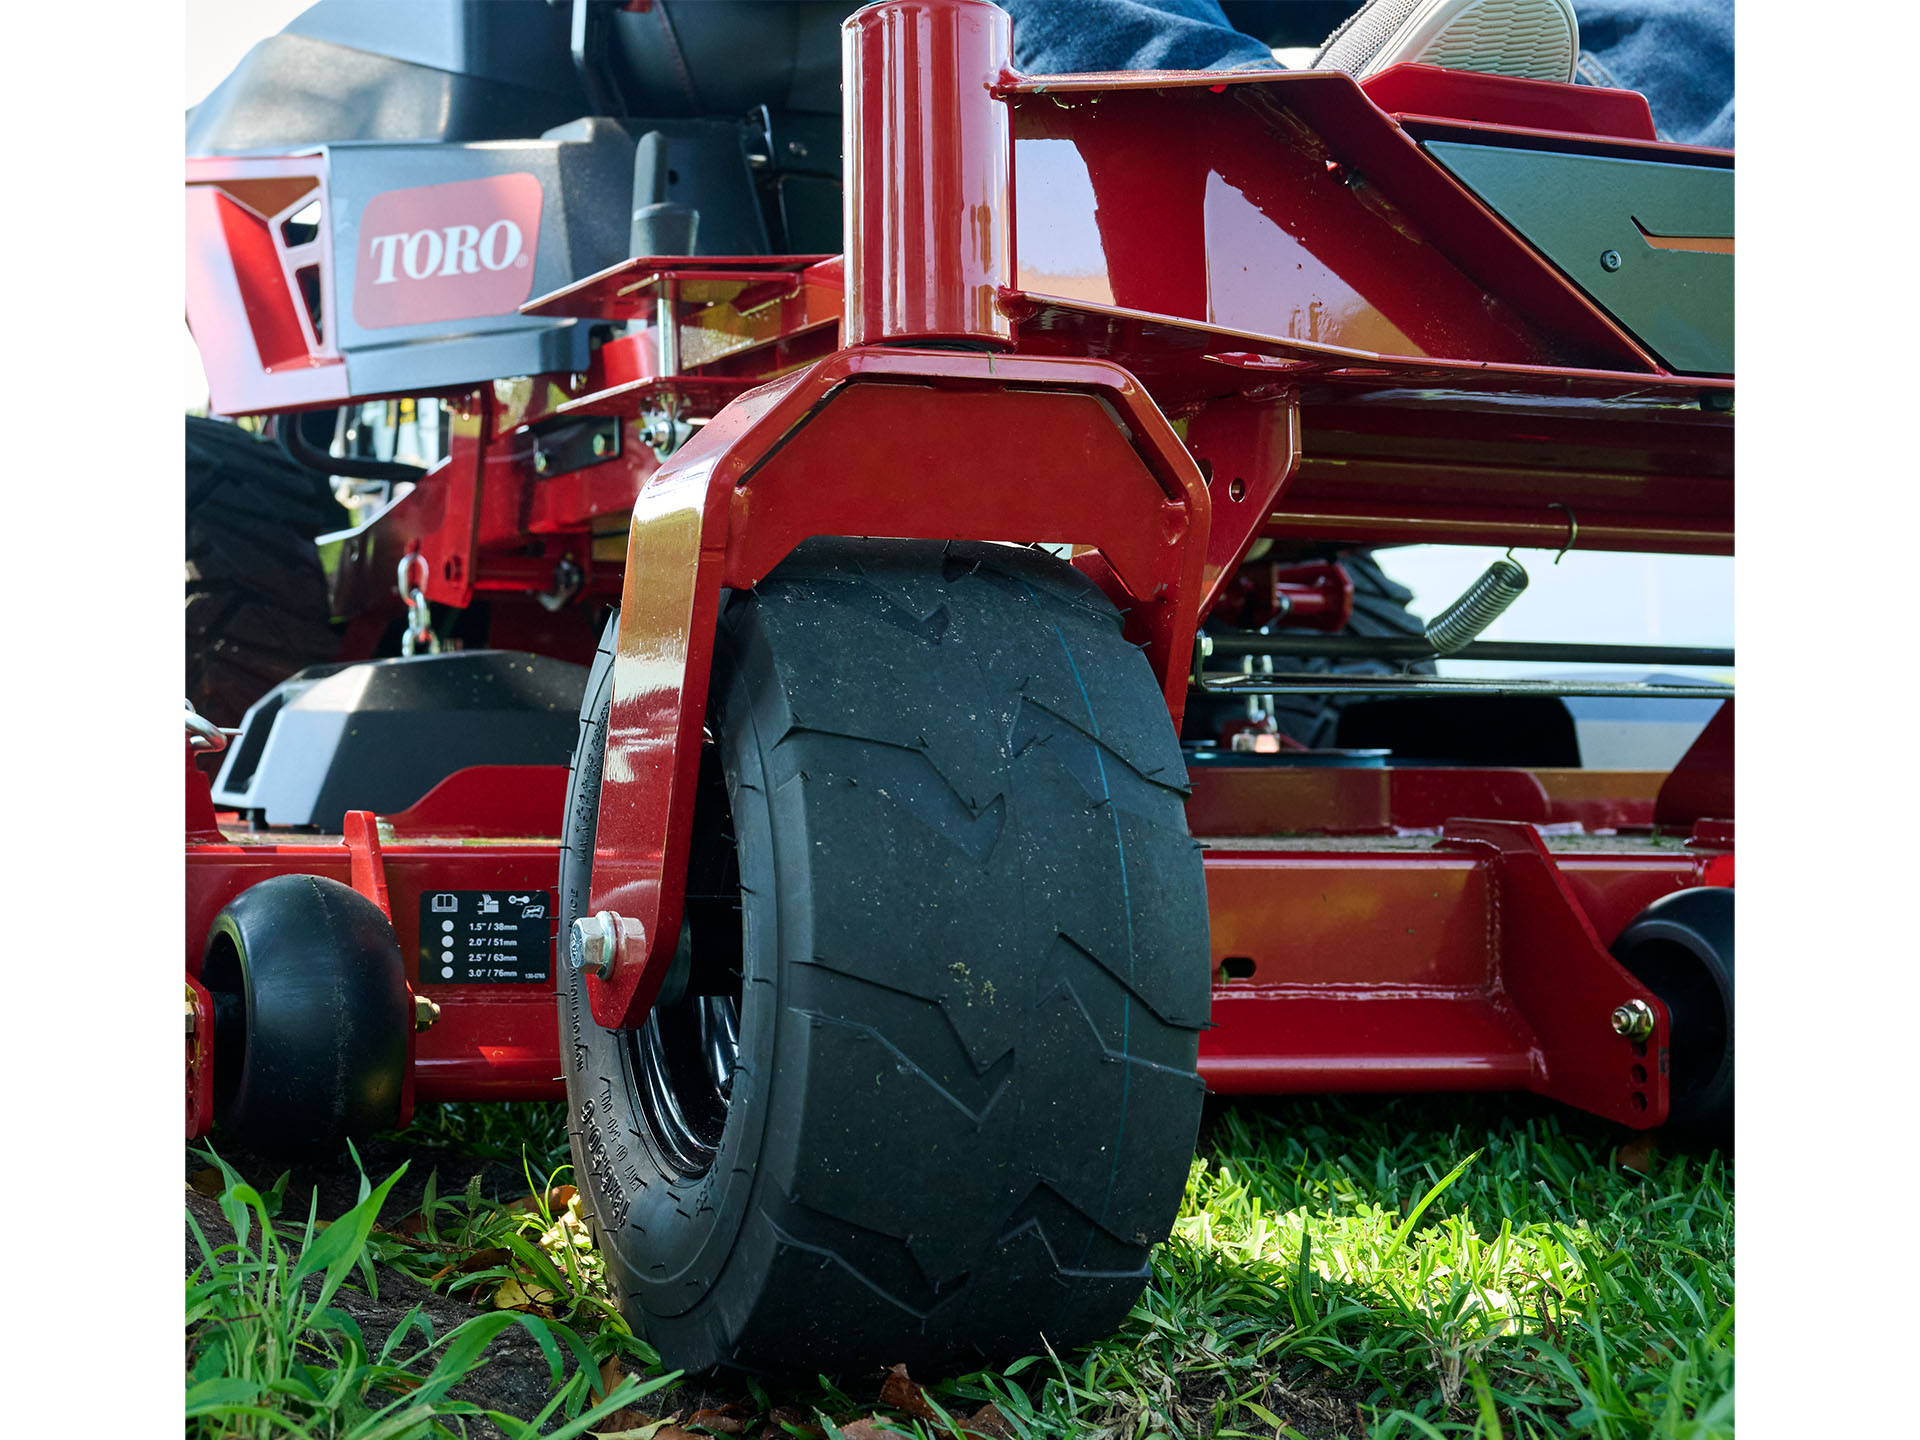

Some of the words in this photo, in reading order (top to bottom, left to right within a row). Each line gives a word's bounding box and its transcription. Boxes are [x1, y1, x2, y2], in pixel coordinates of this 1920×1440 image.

[487, 922, 493, 931] /
[493, 922, 518, 931] 38mm
[487, 938, 493, 946] /
[493, 938, 518, 946] 51mm
[487, 953, 493, 962] /
[493, 953, 518, 962] 63mm
[487, 969, 493, 977] /
[493, 969, 518, 977] 76mm
